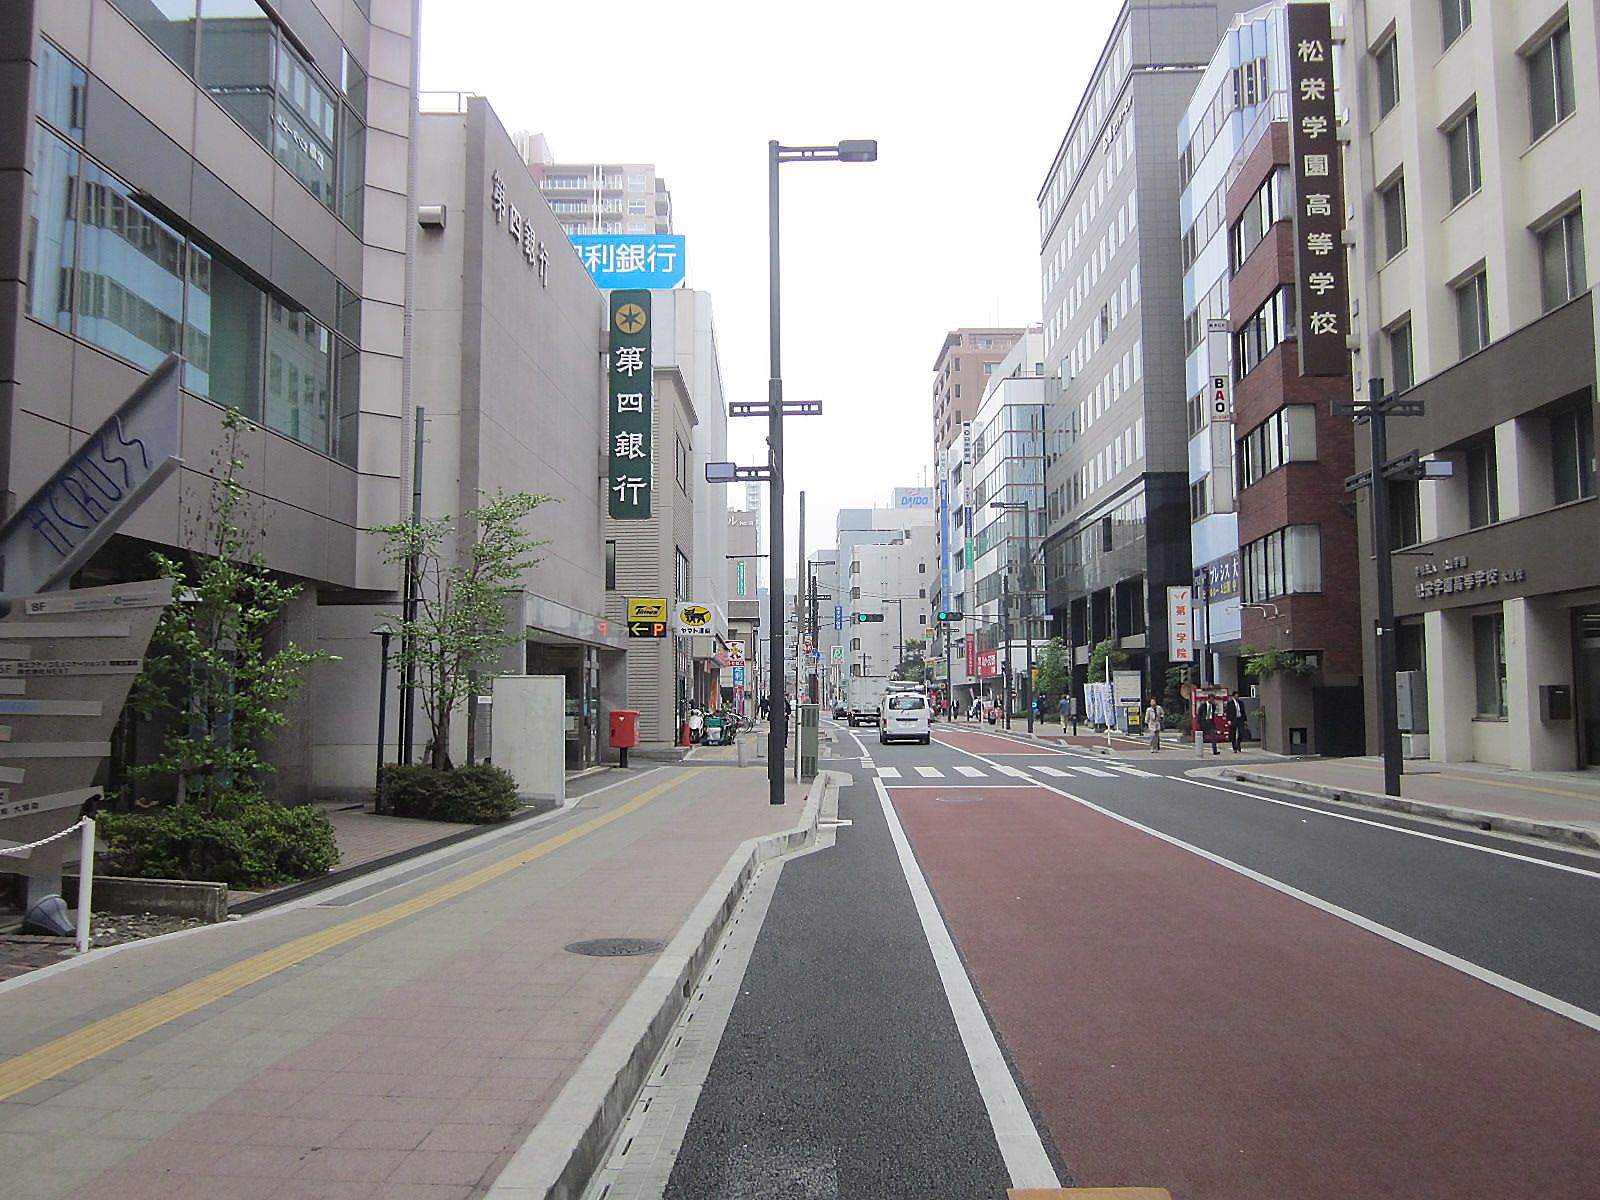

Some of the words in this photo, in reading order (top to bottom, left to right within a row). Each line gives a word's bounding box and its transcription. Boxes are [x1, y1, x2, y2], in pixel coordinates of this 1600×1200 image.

[492, 170, 550, 289] 第四銀行
[1298, 39, 1338, 335] 松栄学園高等学校
[612, 346, 648, 506] 第四銀行
[1214, 378, 1226, 413] BAO
[653, 623, 664, 637] P
[1176, 605, 1187, 659] 第一学院
